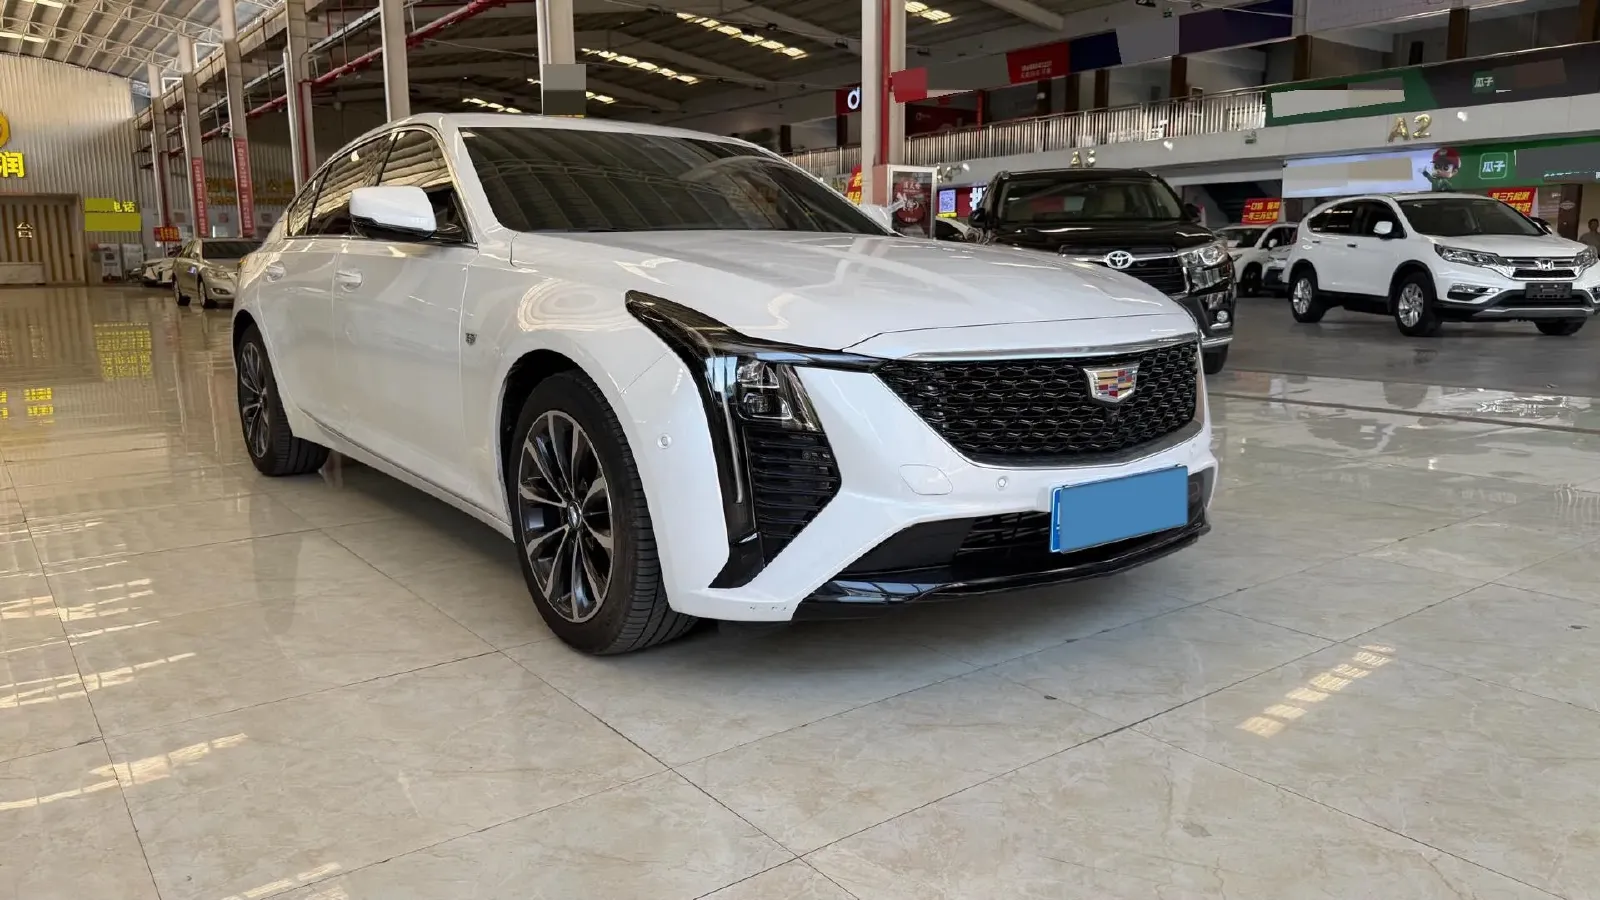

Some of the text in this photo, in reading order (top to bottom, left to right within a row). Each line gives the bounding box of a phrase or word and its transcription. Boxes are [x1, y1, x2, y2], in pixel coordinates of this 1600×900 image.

[1474, 76, 1494, 88] 瓜子
[1387, 114, 1431, 143] A2
[1482, 160, 1506, 173] 瓜子
[17, 221, 33, 238] 台
